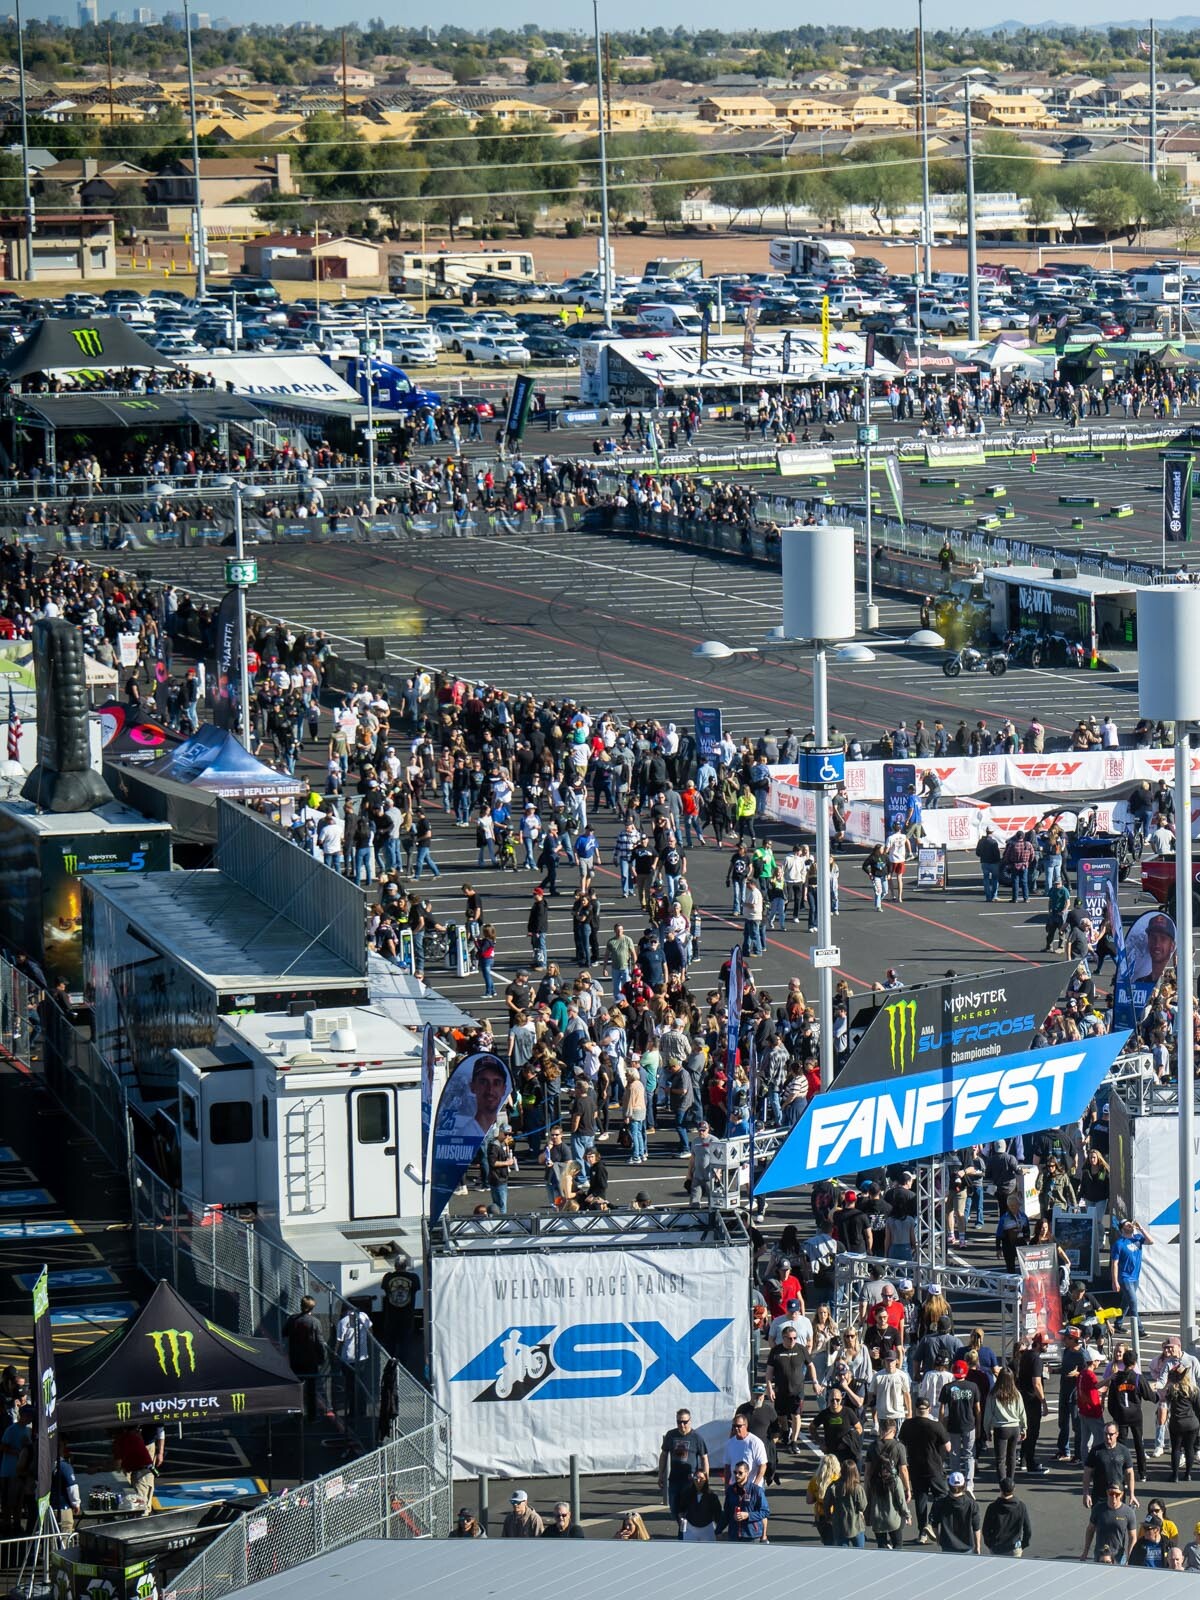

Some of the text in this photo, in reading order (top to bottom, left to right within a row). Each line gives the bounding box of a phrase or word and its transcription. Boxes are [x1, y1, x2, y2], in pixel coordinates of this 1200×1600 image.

[241, 383, 339, 394] YAMAHA
[860, 429, 873, 440] 88
[1172, 472, 1181, 519] Kawasaki
[231, 567, 254, 581] 83
[1053, 605, 1077, 618] MONSTER
[980, 763, 998, 774] FEAR
[1016, 762, 1082, 776] FLY
[1106, 760, 1122, 769] FEAR
[847, 770, 864, 779] FEAR
[980, 774, 998, 783] LESS
[1106, 769, 1122, 777] LESS
[847, 779, 865, 788] LESS
[244, 786, 276, 796] REPLICA
[278, 785, 300, 794] BIKES
[890, 796, 908, 805] WIN
[950, 829, 969, 839] LESS
[129, 852, 147, 871] 5
[1086, 898, 1107, 908] WIN
[944, 988, 1007, 1013] MONSTER
[954, 1007, 998, 1022] ENERGY
[918, 1014, 1035, 1053] SUPERCROSS
[921, 1026, 935, 1036] AMA
[951, 1043, 1001, 1064] Championship
[806, 1053, 1086, 1170] FANFEST
[435, 1144, 474, 1160] MUSQUIN
[495, 1273, 686, 1300] WELCOME RACE FANS!
[141, 1396, 220, 1413] MONSTER
[153, 1411, 209, 1420] ENERGY
